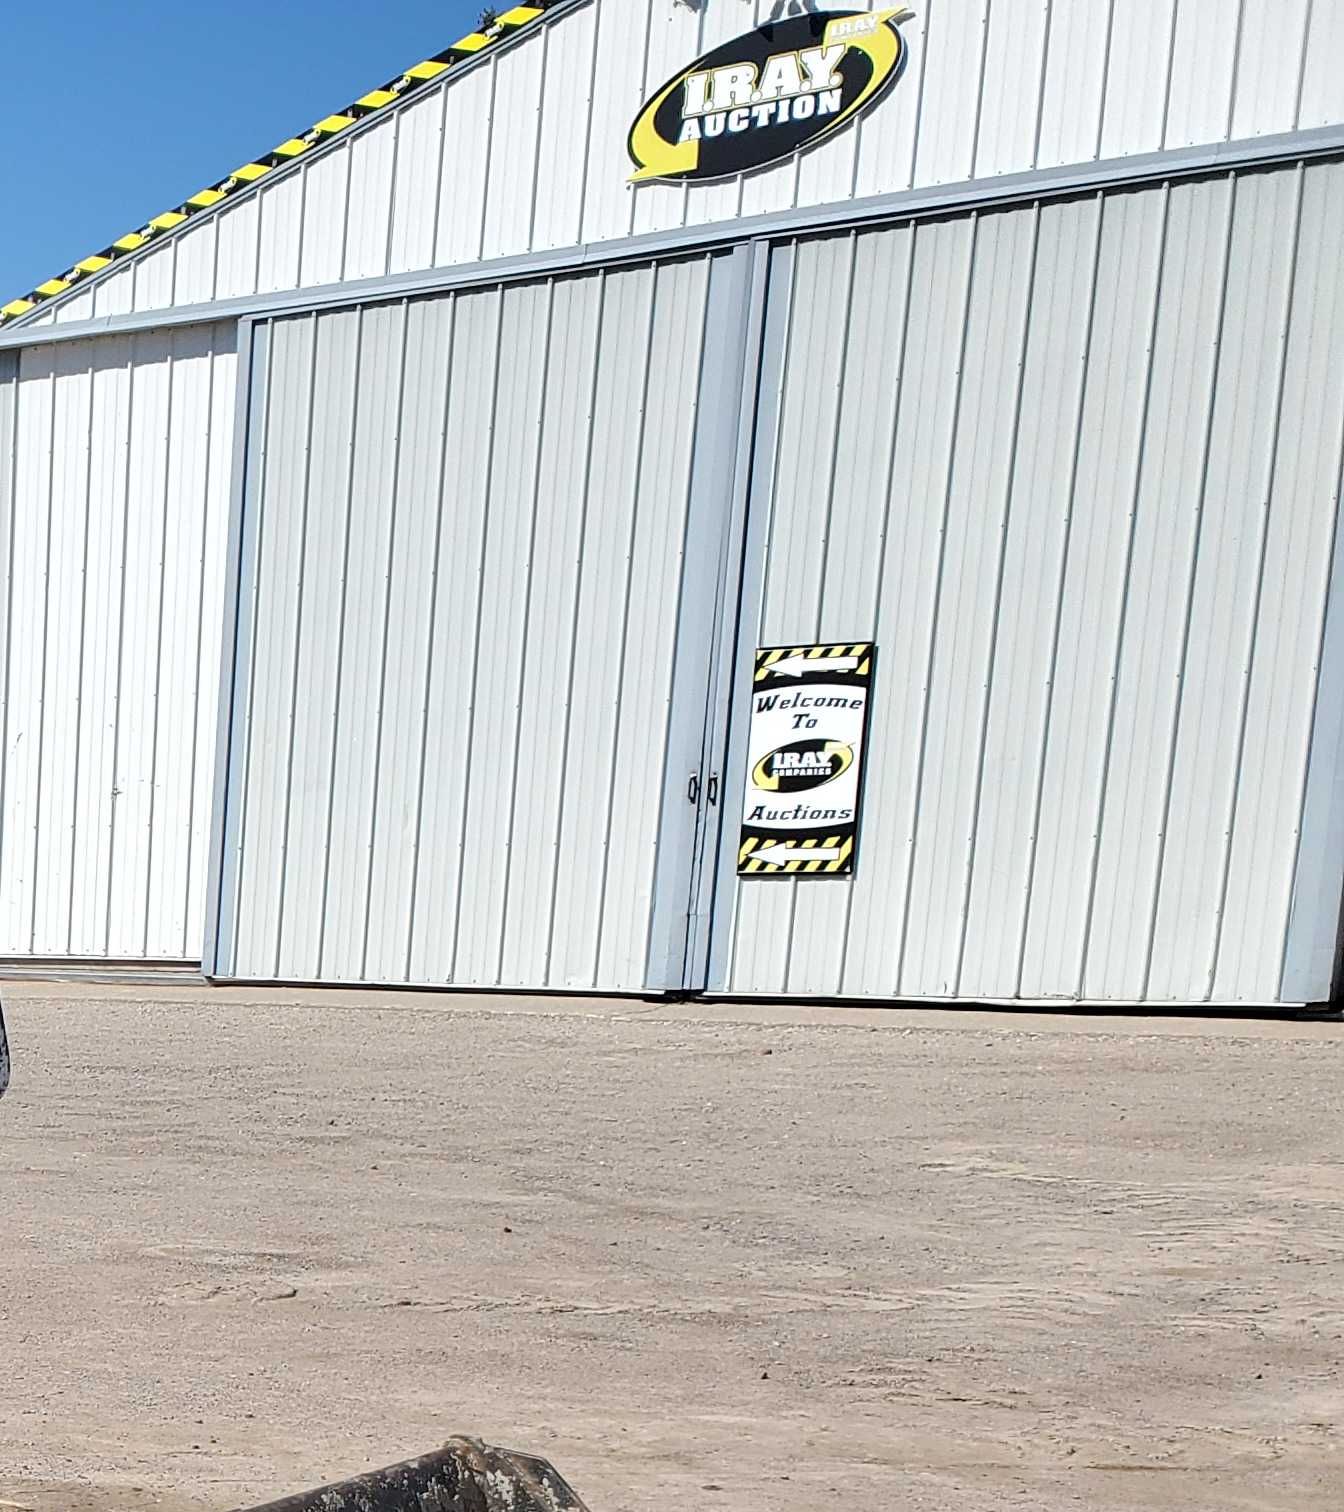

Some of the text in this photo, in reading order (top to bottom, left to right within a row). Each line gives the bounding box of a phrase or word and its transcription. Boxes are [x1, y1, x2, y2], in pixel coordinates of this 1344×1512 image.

[679, 88, 843, 142] AUCTION
[756, 692, 863, 714] Welcome
[792, 713, 818, 729] To
[773, 767, 831, 776] COMPANIES
[747, 804, 852, 821] Auctions
